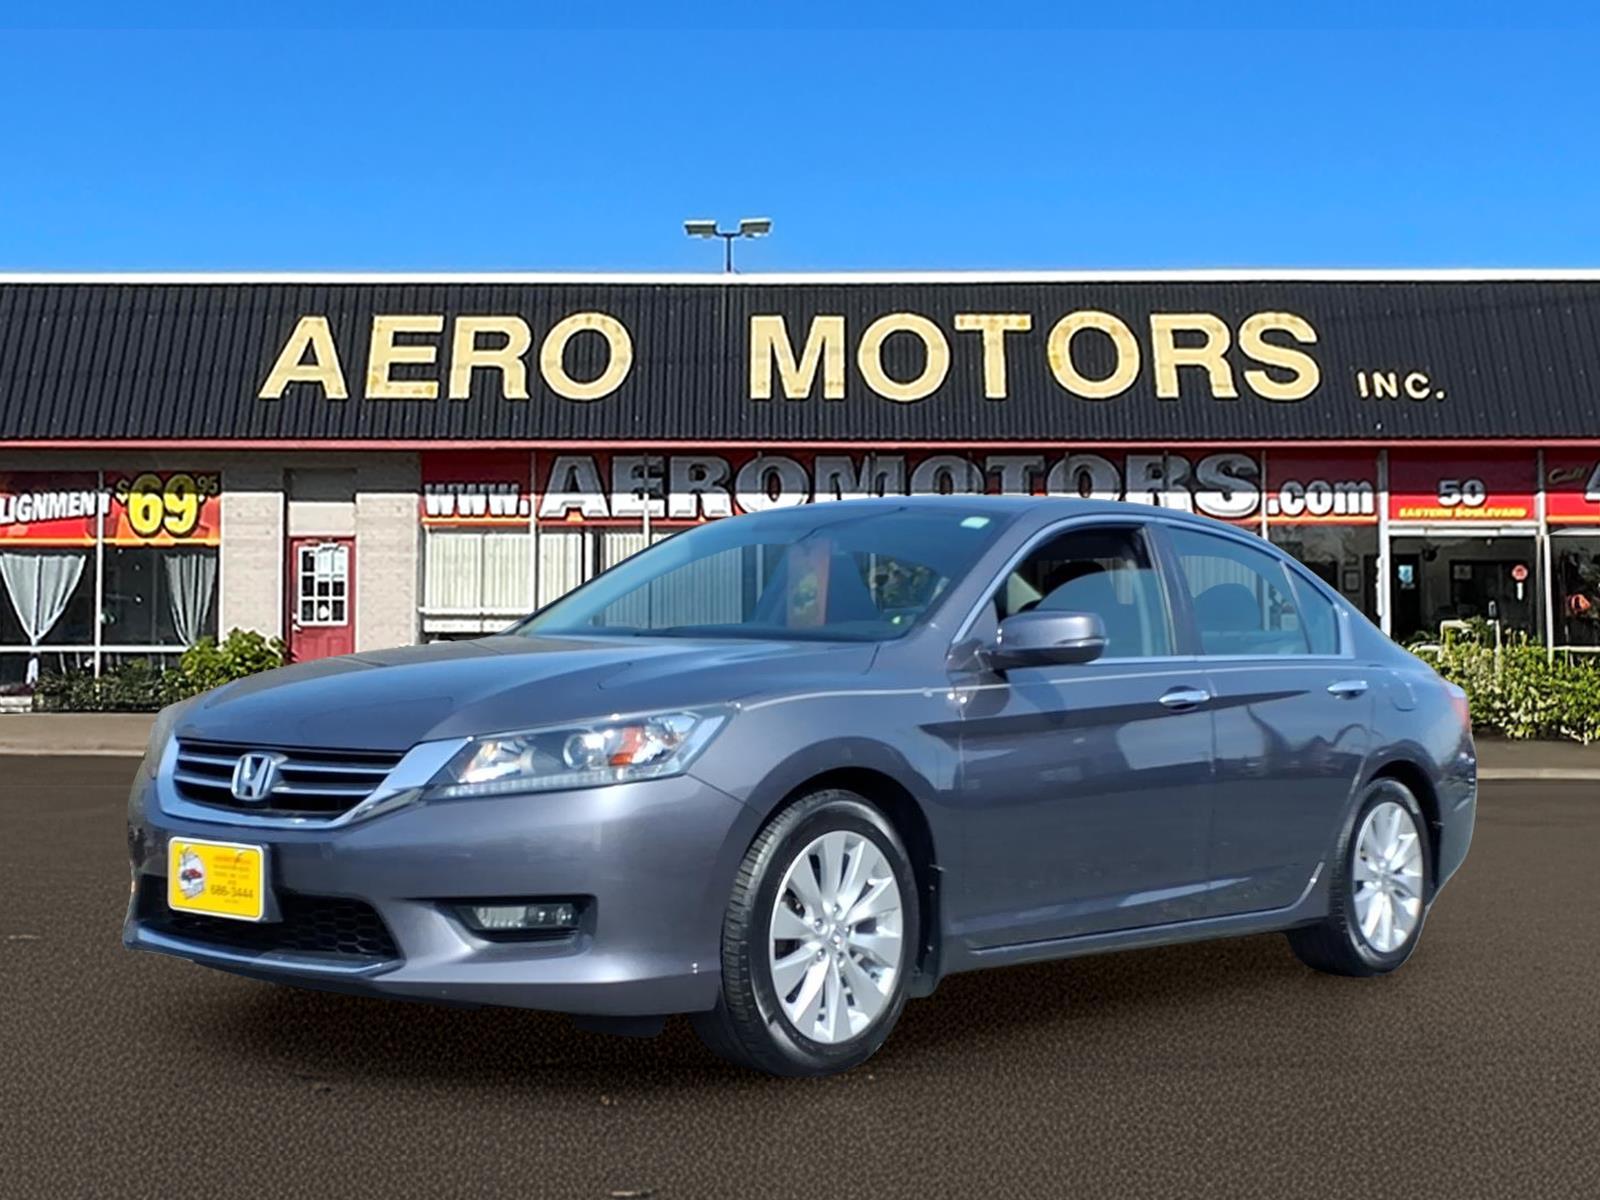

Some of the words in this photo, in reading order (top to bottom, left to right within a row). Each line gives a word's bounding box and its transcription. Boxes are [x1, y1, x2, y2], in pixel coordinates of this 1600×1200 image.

[258, 312, 633, 400] AERO
[750, 310, 1320, 402] MOTORS
[1357, 372, 1447, 400] INC.
[1438, 479, 1486, 506] 50
